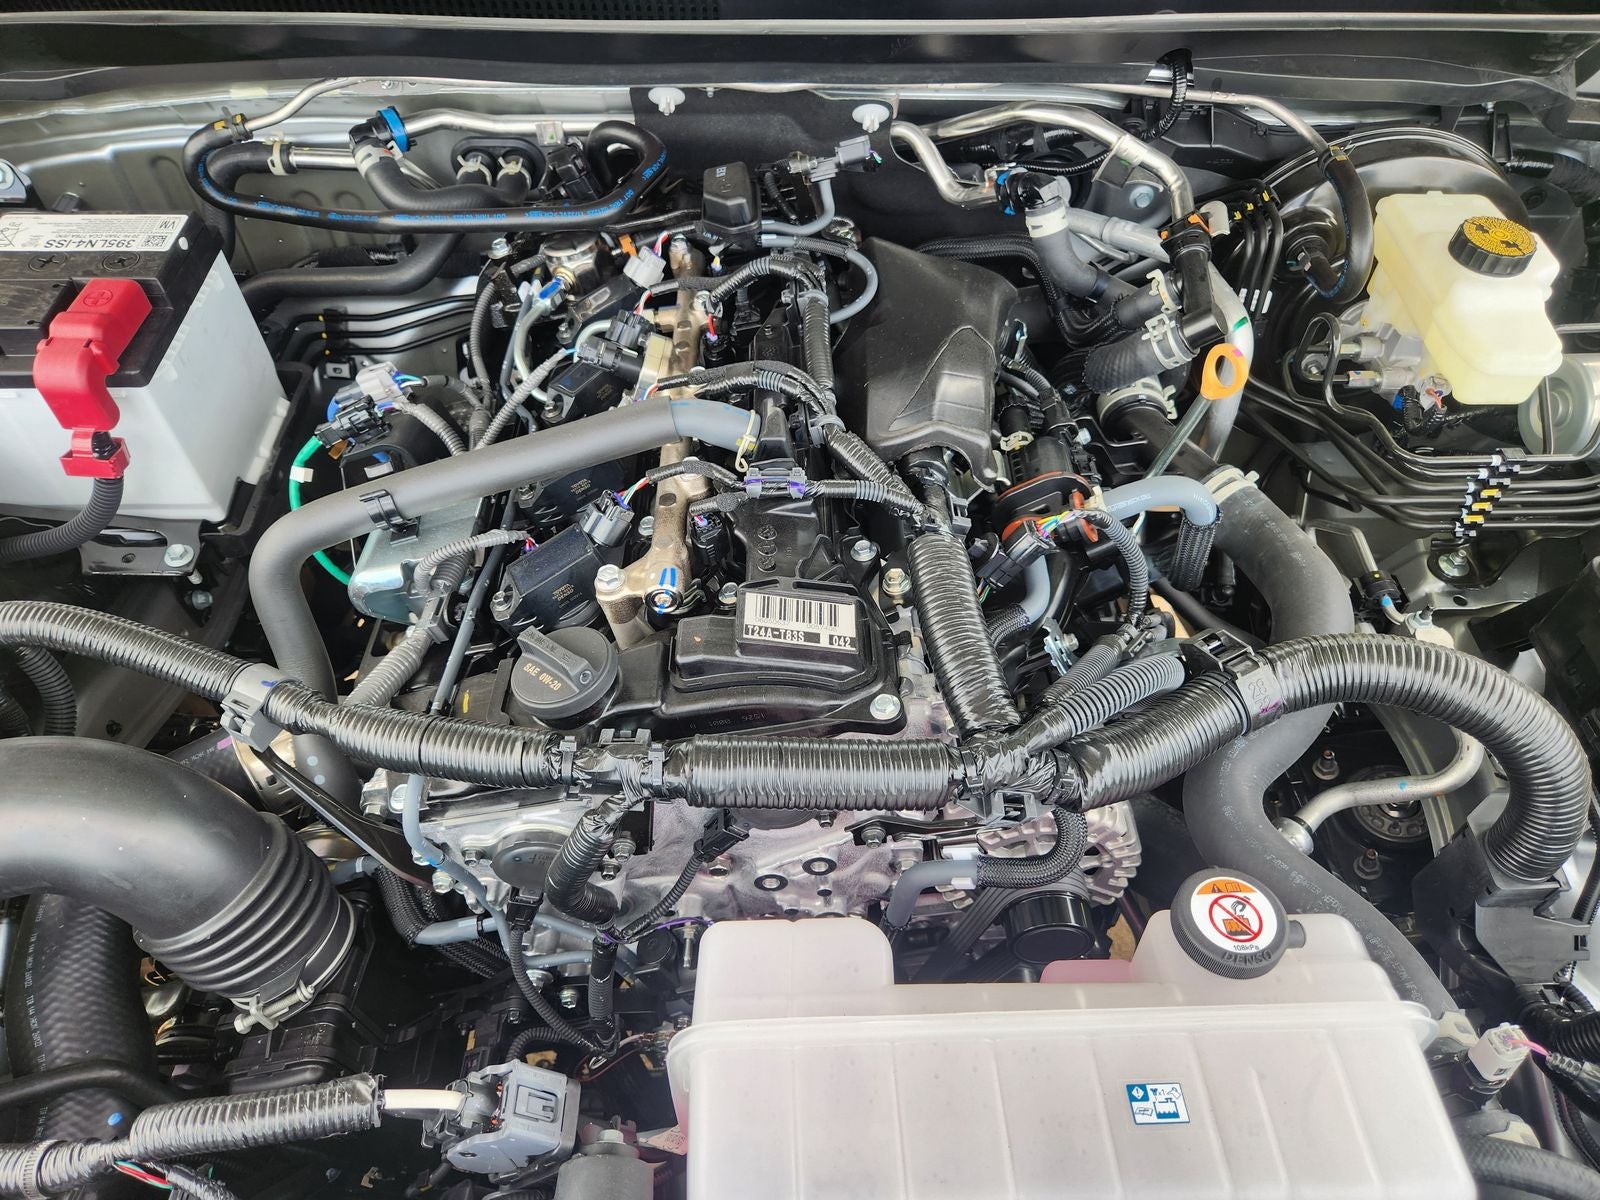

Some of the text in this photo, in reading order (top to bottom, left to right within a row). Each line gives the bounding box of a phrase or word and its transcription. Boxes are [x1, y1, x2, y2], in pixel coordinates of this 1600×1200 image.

[44, 239, 135, 248] 395LN4-ISS
[747, 624, 805, 642] T24A-T83S
[832, 635, 851, 648] 042
[523, 663, 562, 691] SAE 0W-20
[1233, 943, 1260, 952] 108kPa
[1221, 948, 1273, 967] DENSO
